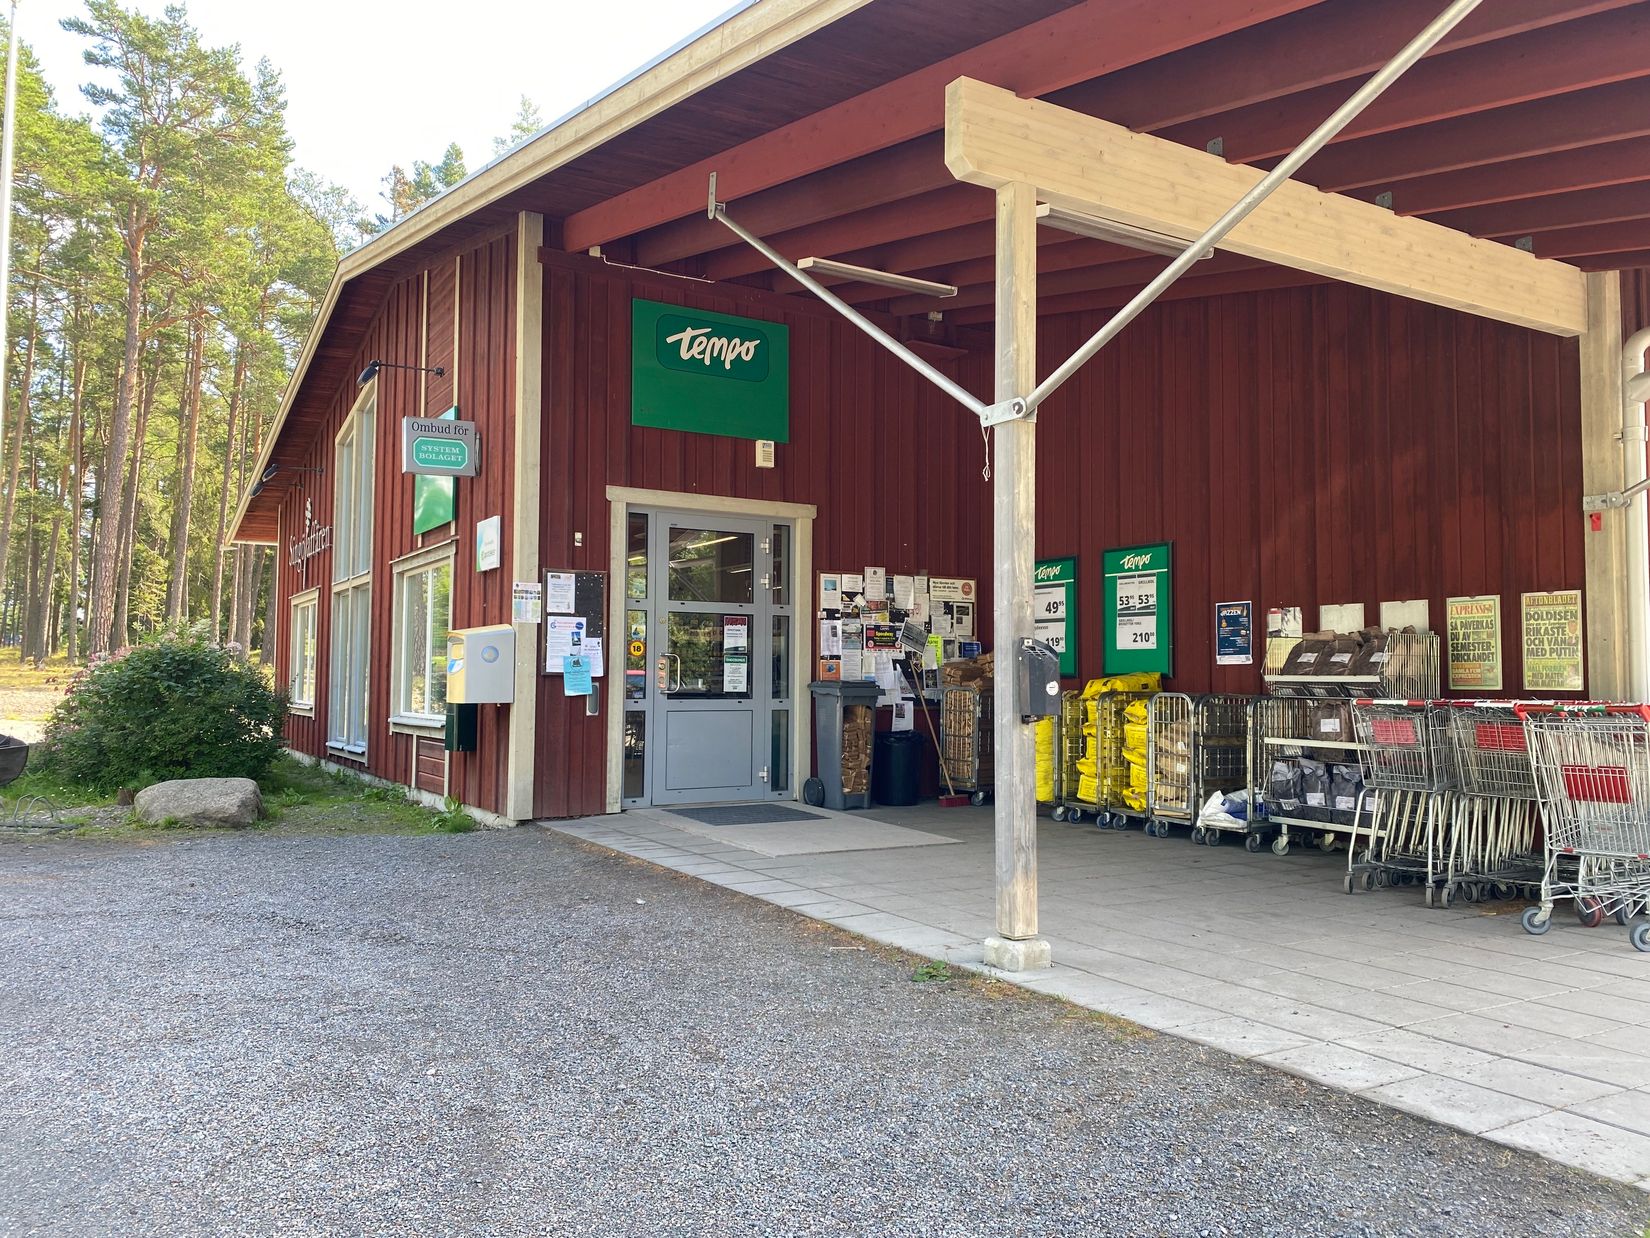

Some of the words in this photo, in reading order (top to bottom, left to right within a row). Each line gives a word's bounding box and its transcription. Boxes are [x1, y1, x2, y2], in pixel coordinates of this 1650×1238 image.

[411, 421, 451, 434] Ombud
[453, 424, 469, 435] för
[420, 445, 460, 454] SYSTEM
[418, 453, 463, 462] BOLAGET
[1119, 595, 1130, 606] 53
[1138, 594, 1150, 605] 53
[1525, 594, 1577, 605] AFTONBLADET
[1045, 601, 1059, 614] 49
[1525, 609, 1578, 622] DOLDISEN
[1460, 618, 1494, 631] PÅVERKAS
[1450, 631, 1461, 642] DU
[1461, 631, 1472, 641] AV
[1525, 626, 1567, 637] RIKASTE
[1132, 632, 1150, 643] 210
[1525, 637, 1545, 647] OCH
[1450, 641, 1495, 653] SEMESTER-
[1526, 647, 1547, 657] MED
[1548, 646, 1578, 658] PUTIN
[1451, 652, 1495, 663] DRICKANDET
